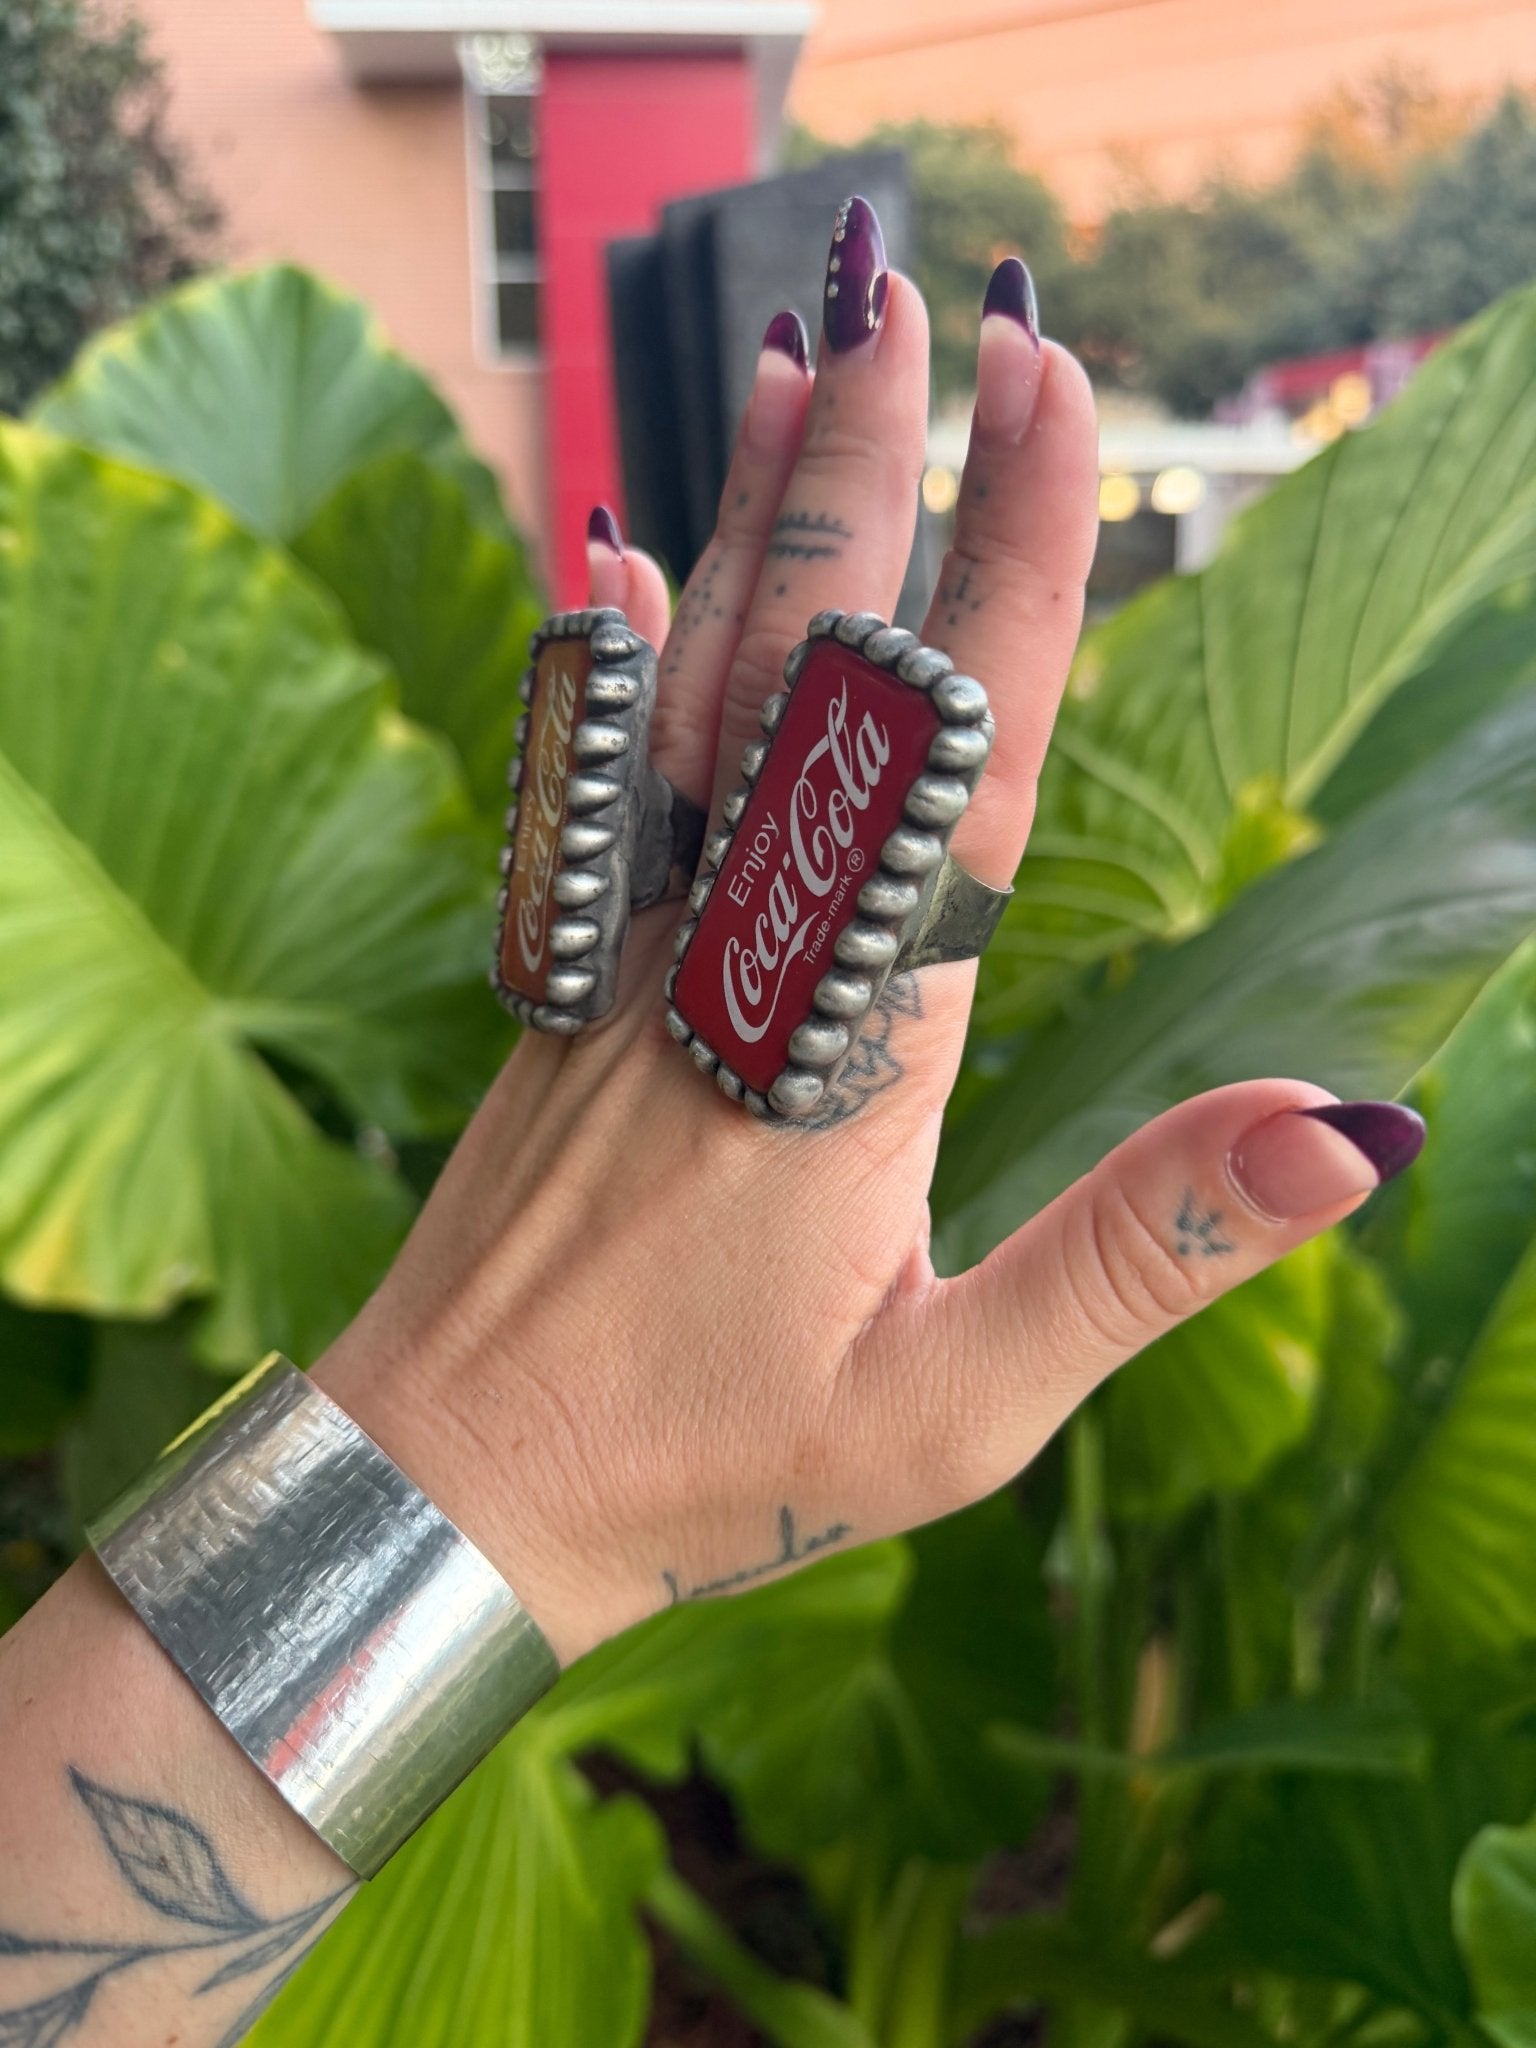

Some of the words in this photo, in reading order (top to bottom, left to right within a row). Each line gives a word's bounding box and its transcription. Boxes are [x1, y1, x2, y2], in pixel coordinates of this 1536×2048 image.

[517, 664, 577, 973] Coca-Cola
[722, 676, 889, 1043] Coca-Cola
[727, 811, 780, 908] Enjoy
